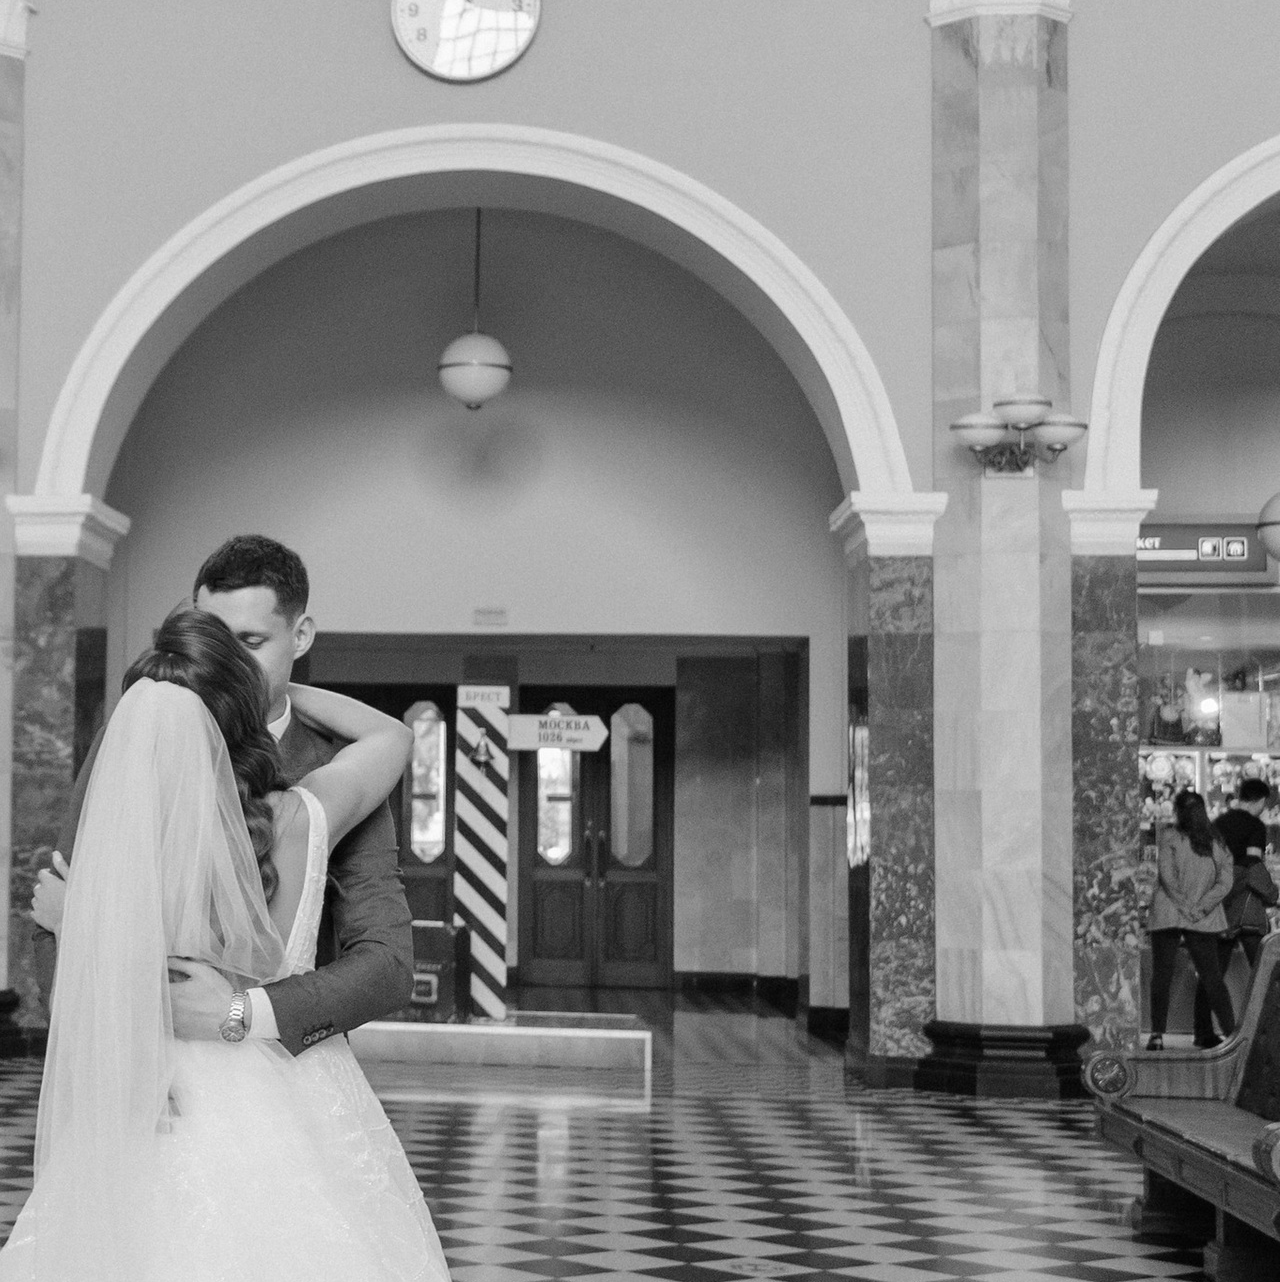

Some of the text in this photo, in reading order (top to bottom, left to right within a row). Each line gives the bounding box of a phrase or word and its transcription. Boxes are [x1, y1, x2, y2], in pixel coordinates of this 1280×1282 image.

[408, 2, 419, 18] 9
[416, 27, 427, 41] 8
[465, 691, 502, 702] БРЕСТ
[538, 719, 590, 731] МОСКВА
[538, 731, 563, 742] 1026
